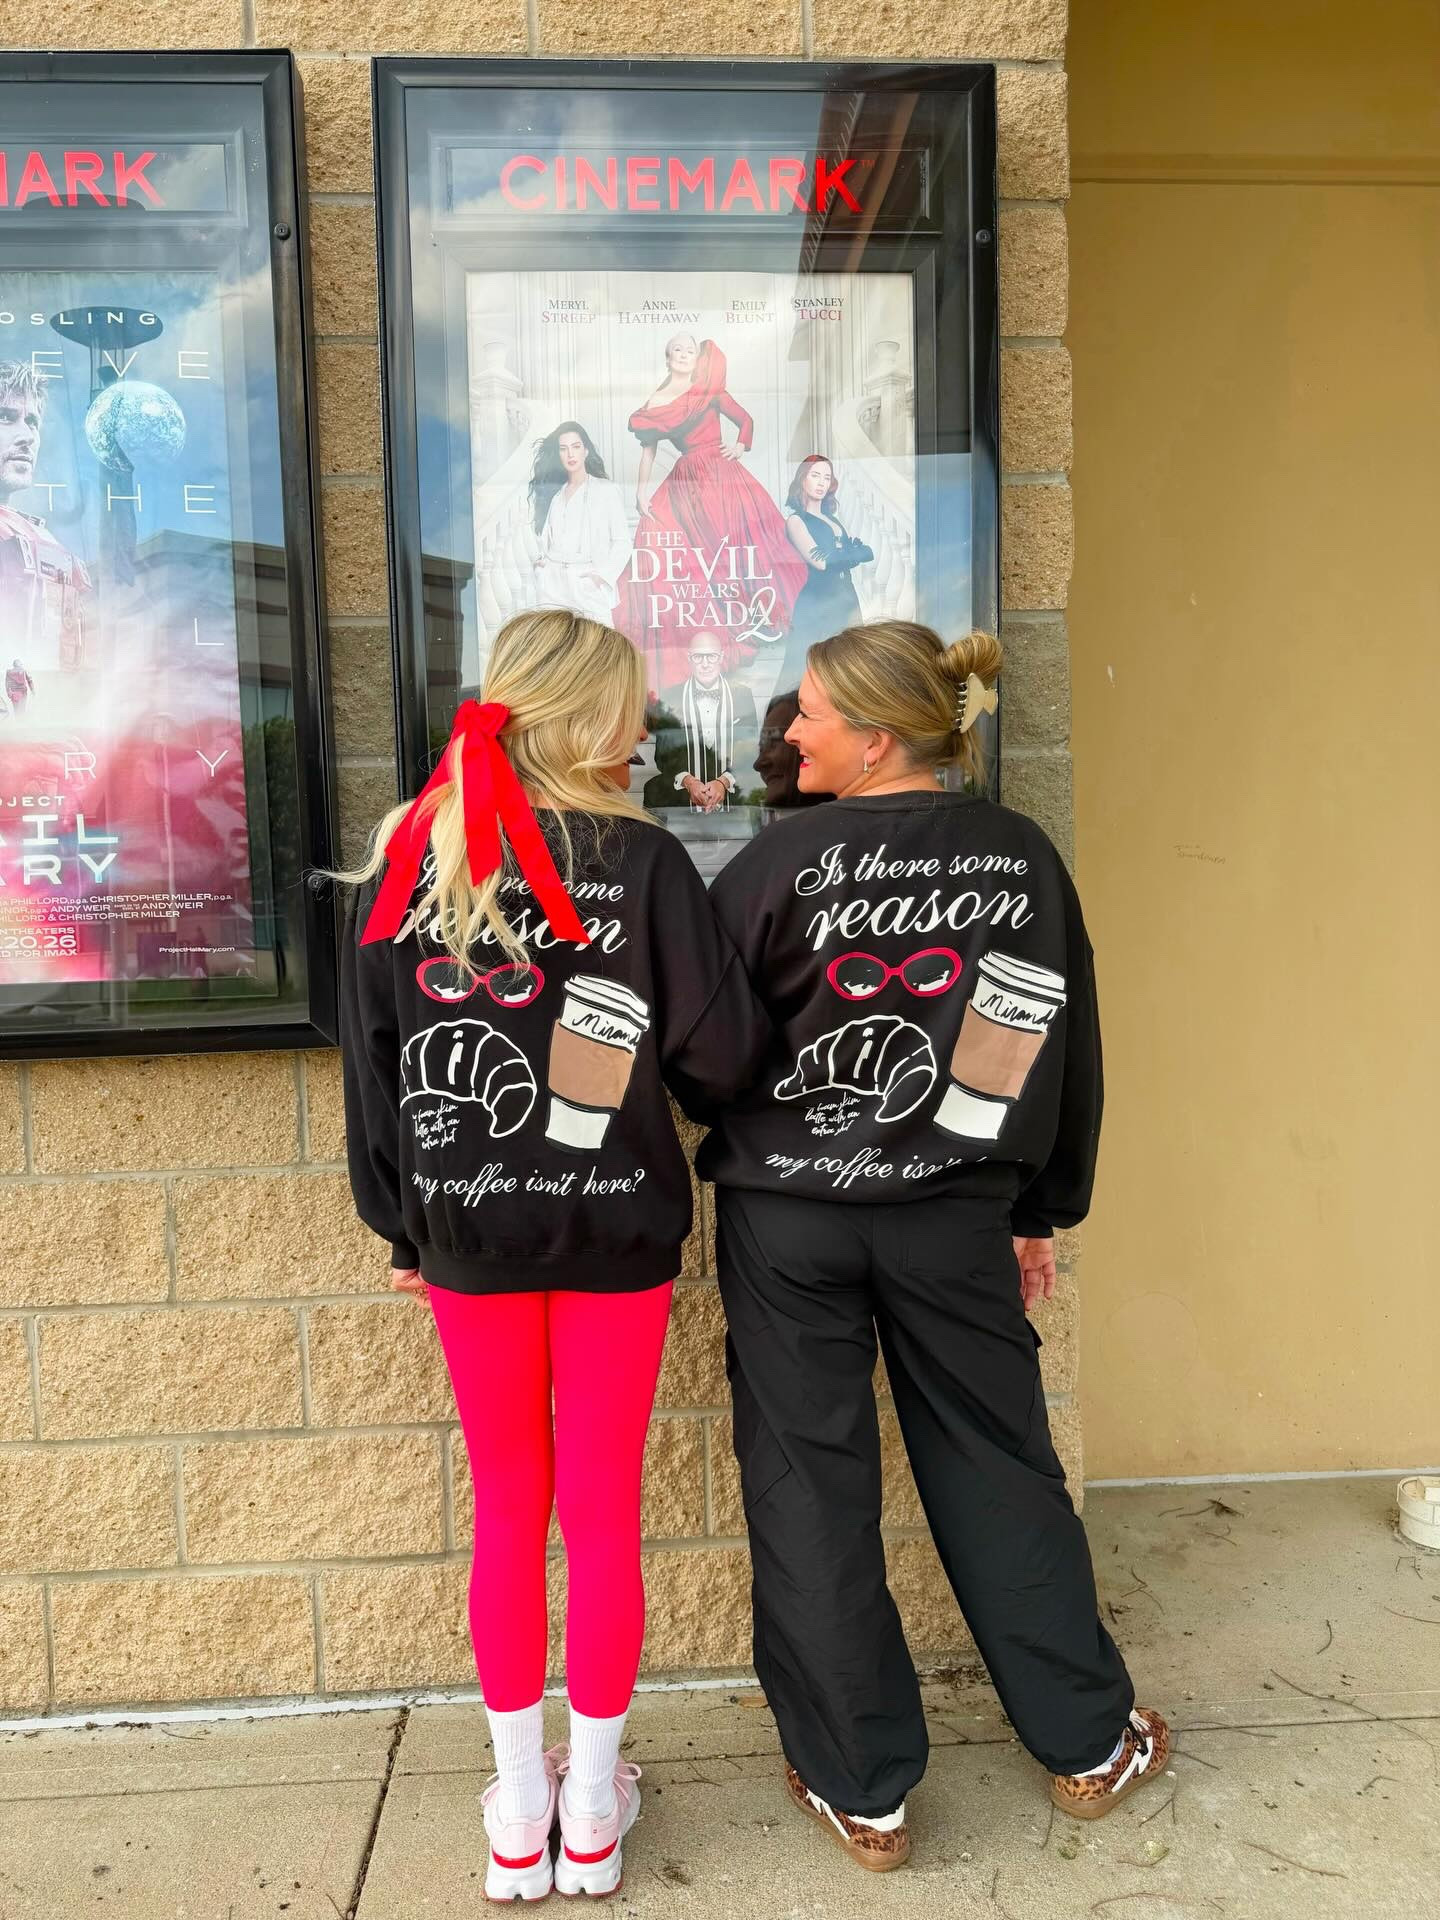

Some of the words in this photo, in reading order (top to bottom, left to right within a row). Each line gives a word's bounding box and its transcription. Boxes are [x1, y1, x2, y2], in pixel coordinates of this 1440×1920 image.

[500, 155, 863, 212] CINEMARK
[548, 299, 589, 310] MERYL
[642, 299, 676, 311] ANNE
[732, 299, 767, 311] EMILY
[794, 297, 844, 308] STANLEY
[0, 311, 157, 326] OSLING
[541, 310, 596, 324] STREEP
[618, 311, 700, 324] HATHAWAY
[726, 311, 774, 324] BLUNT
[800, 309, 842, 321] TUCCI
[34, 483, 218, 514] THE
[641, 531, 685, 547] THE
[628, 535, 773, 583] DEVIL
[671, 583, 740, 599] WEARS
[648, 594, 774, 629] PRADA
[0, 795, 65, 808] JECT
[0, 813, 119, 847] IL
[0, 852, 118, 887] RY
[795, 843, 847, 896] Is
[854, 843, 941, 882] there
[949, 854, 1028, 875] some
[89, 893, 170, 904] CHRISTOPHER
[141, 902, 173, 910] ANDY
[174, 901, 204, 909] WEIR
[50, 904, 82, 913] ANDY
[82, 904, 111, 912] WEIR
[58, 911, 139, 921] CHRISTOPHER
[140, 910, 180, 918] MILLER
[805, 889, 1034, 951] reason
[10, 927, 75, 935] THEATERS
[44, 948, 78, 957] IMAX
[804, 1107, 827, 1124] latte
[847, 1111, 860, 1119] an
[811, 1123, 835, 1137] extra
[765, 1151, 812, 1179] my
[813, 1147, 894, 1189] coffee
[442, 1162, 518, 1207] coffee
[525, 1169, 578, 1196] isn't
[582, 1165, 646, 1196] here?
